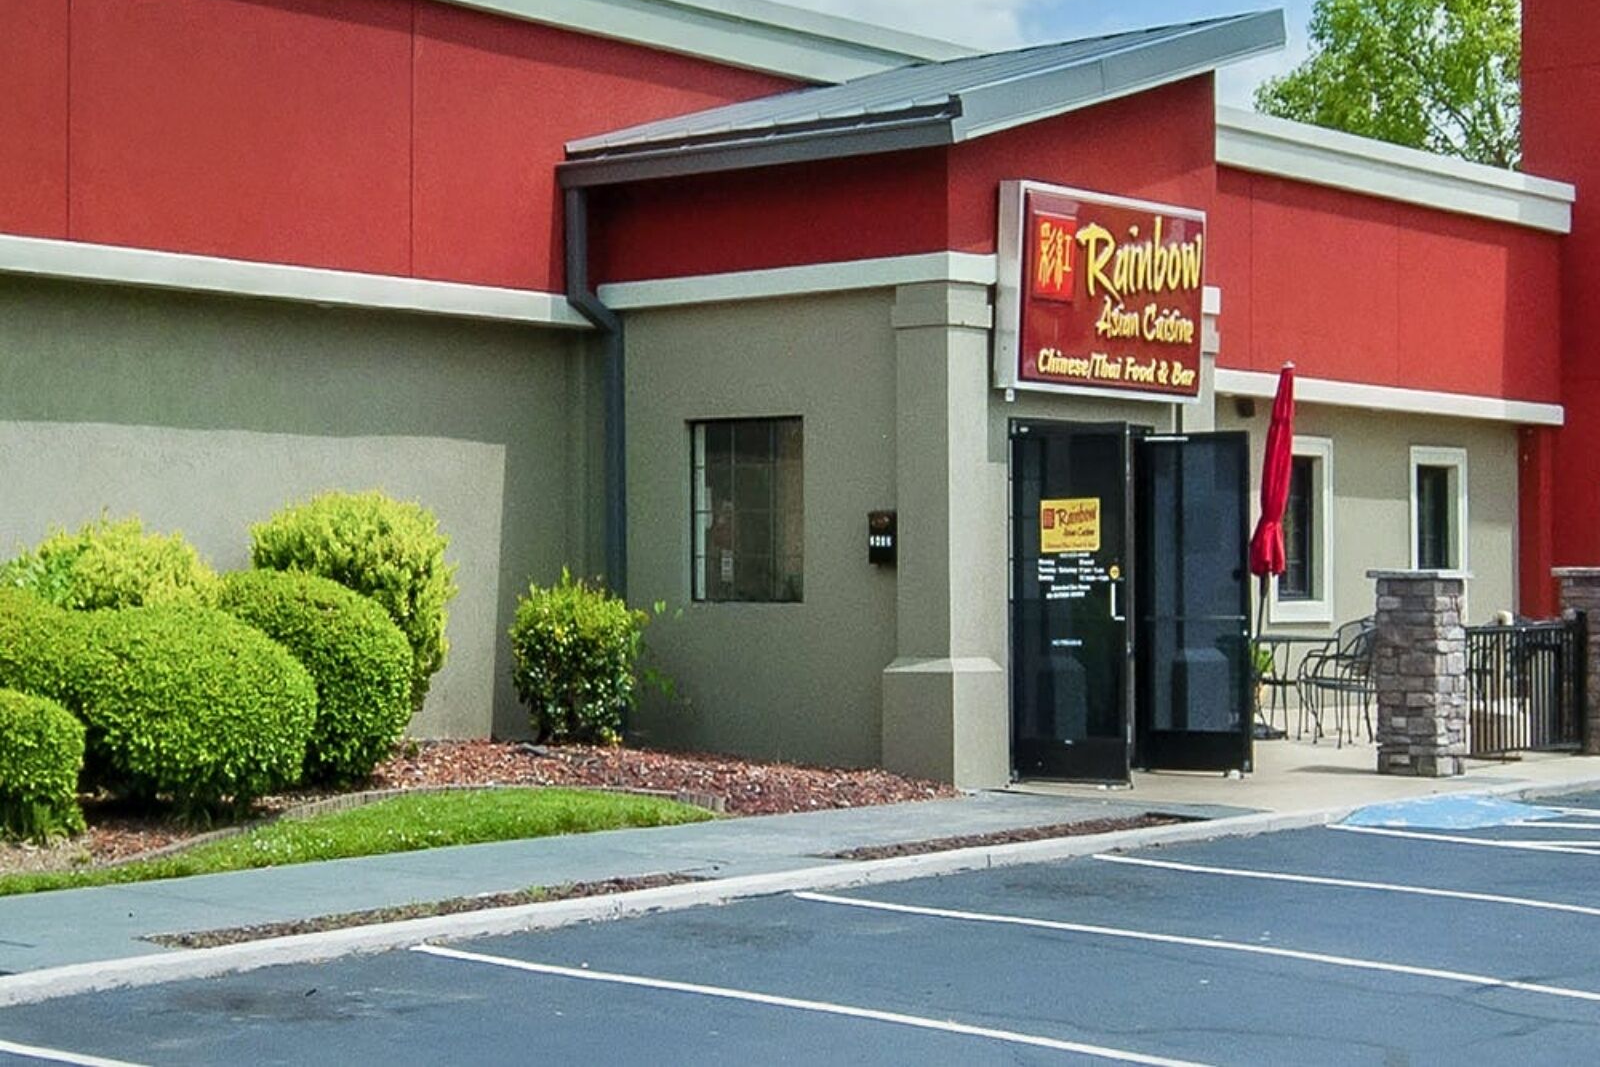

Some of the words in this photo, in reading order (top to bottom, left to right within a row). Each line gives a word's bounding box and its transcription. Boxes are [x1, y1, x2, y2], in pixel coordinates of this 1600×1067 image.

[1075, 216, 1203, 302] Rainbow
[1095, 295, 1140, 339] Asian
[1143, 303, 1194, 344] Cuisine
[1037, 348, 1122, 379] Chinese/Thai
[1124, 357, 1156, 383] Food
[1157, 361, 1169, 384] &
[1171, 361, 1196, 386] Bar
